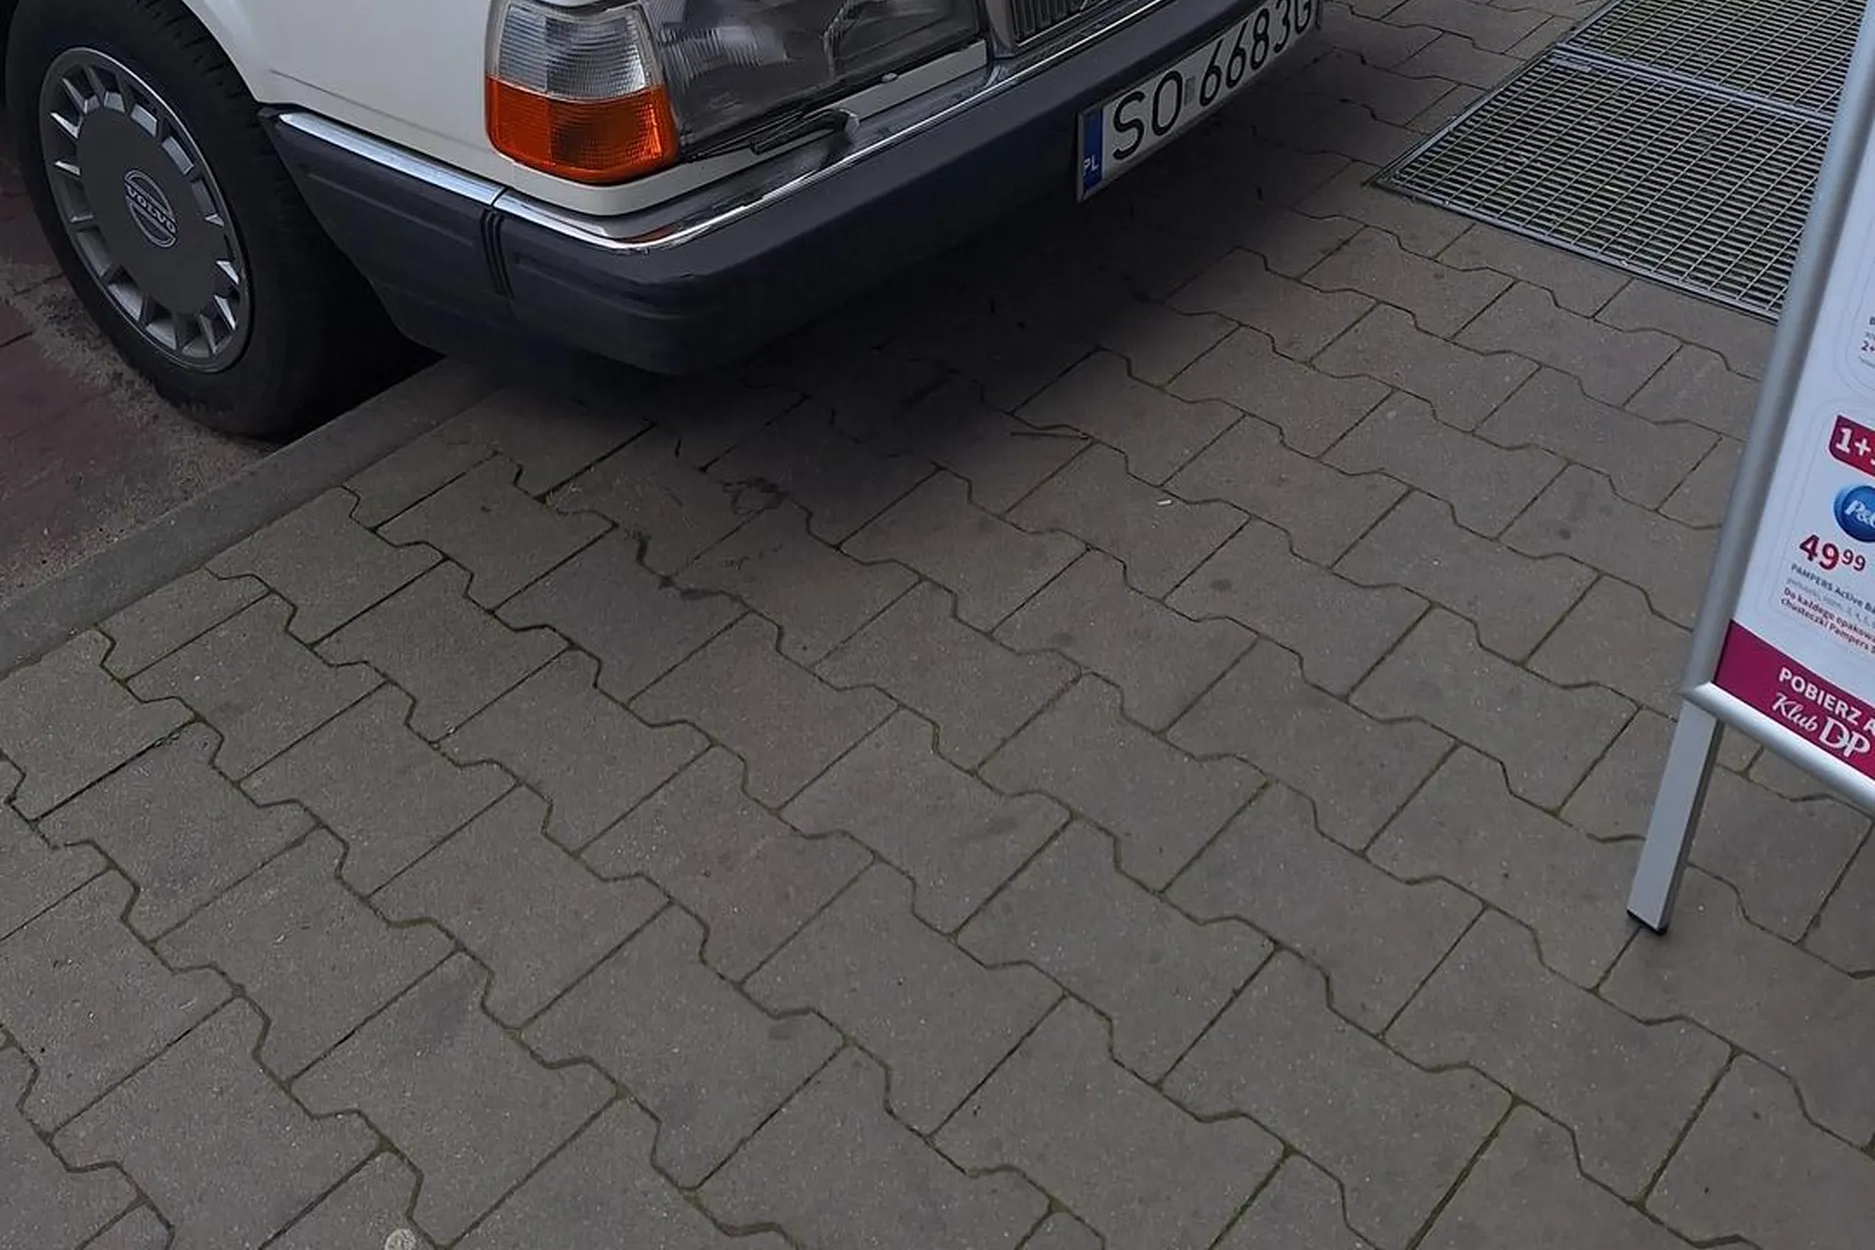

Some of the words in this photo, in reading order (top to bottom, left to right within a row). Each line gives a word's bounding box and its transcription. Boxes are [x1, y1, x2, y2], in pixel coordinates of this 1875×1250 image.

[1112, 70, 1183, 160] SO
[1082, 154, 1099, 176] PL
[124, 183, 177, 235] VOLVO
[1835, 427, 1875, 466] 1+
[1772, 692, 1818, 732] Klub
[1779, 667, 1862, 726] POBIERZ
